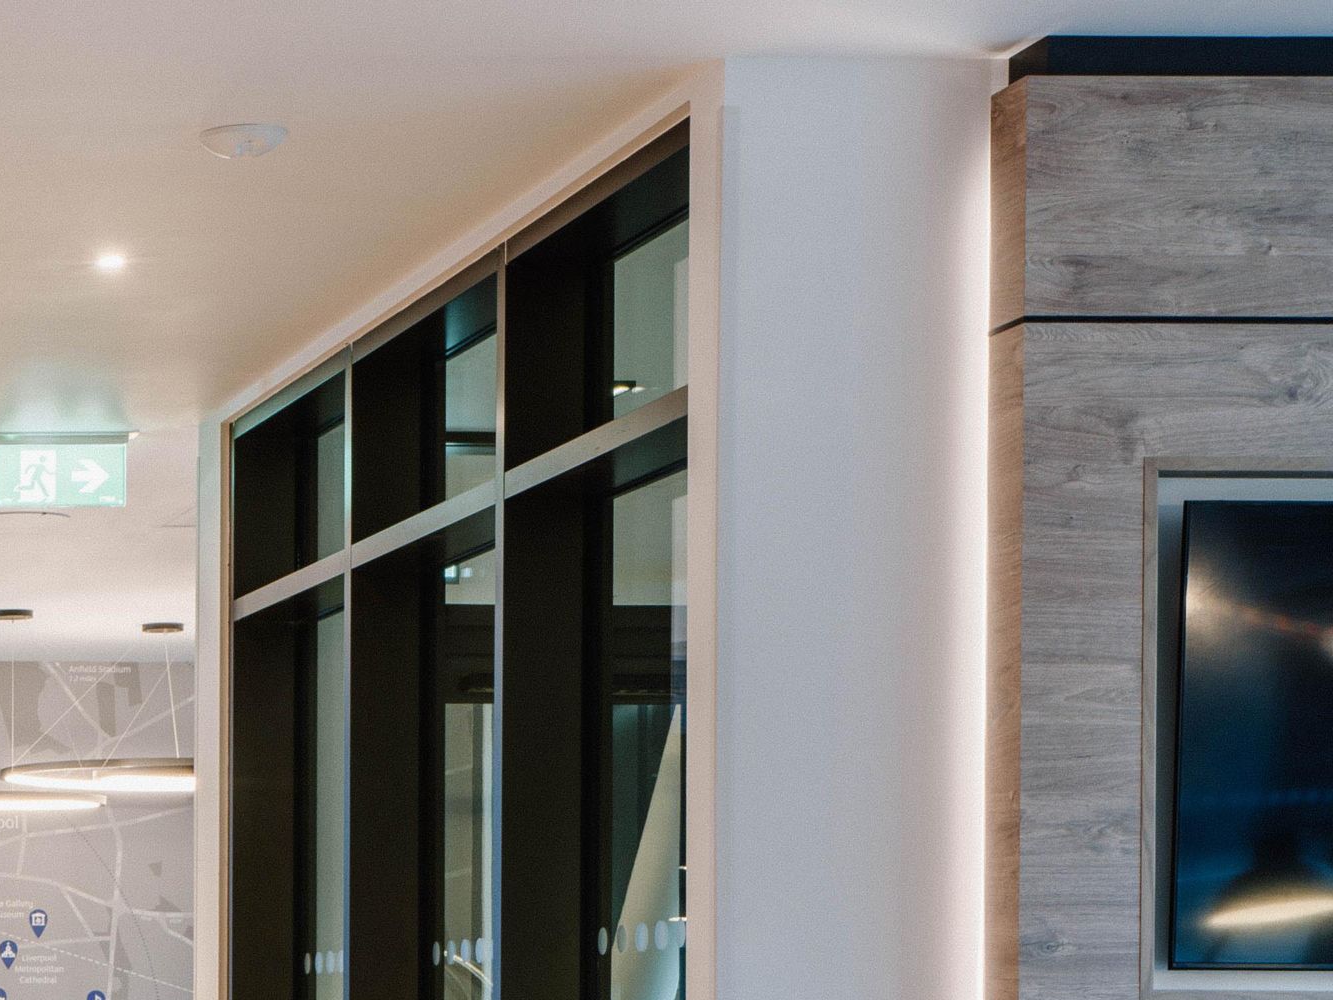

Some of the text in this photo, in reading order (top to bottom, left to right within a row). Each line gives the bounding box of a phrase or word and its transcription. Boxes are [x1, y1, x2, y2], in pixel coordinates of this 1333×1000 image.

[99, 665, 131, 673] Stadium
[21, 954, 57, 964] Liverpool
[15, 965, 64, 975] Metropolitan
[19, 976, 58, 985] Cathedral
